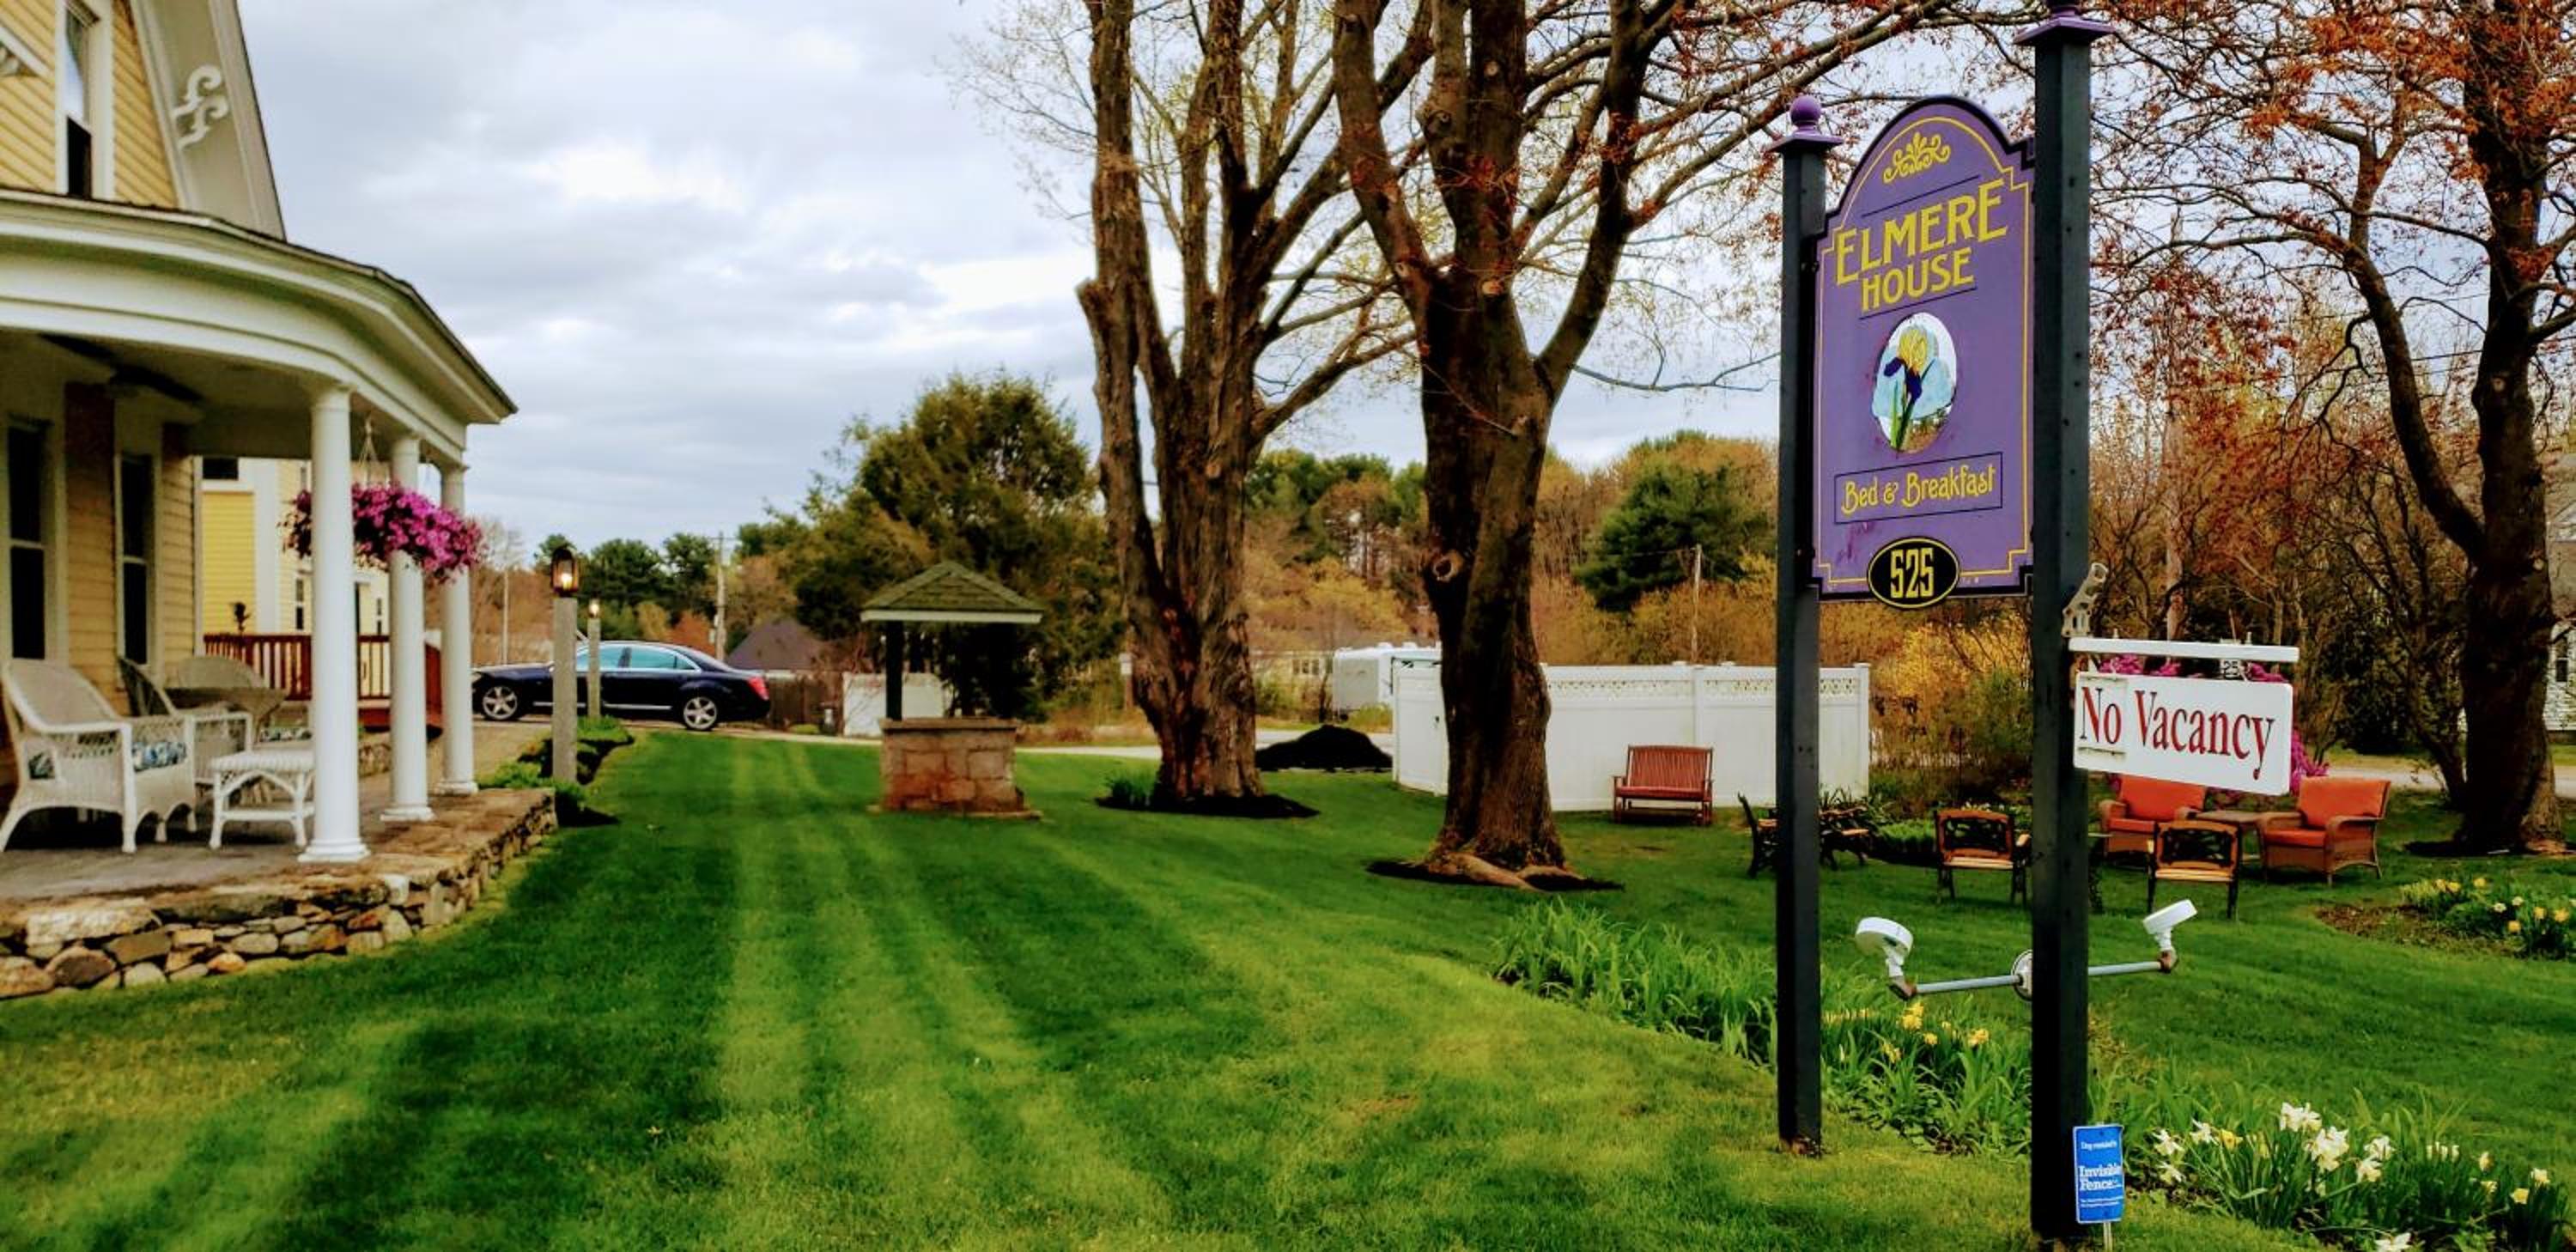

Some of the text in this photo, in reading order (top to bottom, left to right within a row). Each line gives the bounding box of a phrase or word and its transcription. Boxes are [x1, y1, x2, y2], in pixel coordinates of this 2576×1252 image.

[1835, 179, 2008, 285] ELMERE
[1861, 248, 1975, 313] HOUSE
[1841, 464, 1996, 514] Bed & Breakfast
[1891, 547, 1935, 599] 525
[2080, 686, 2275, 781] No Vacancy
